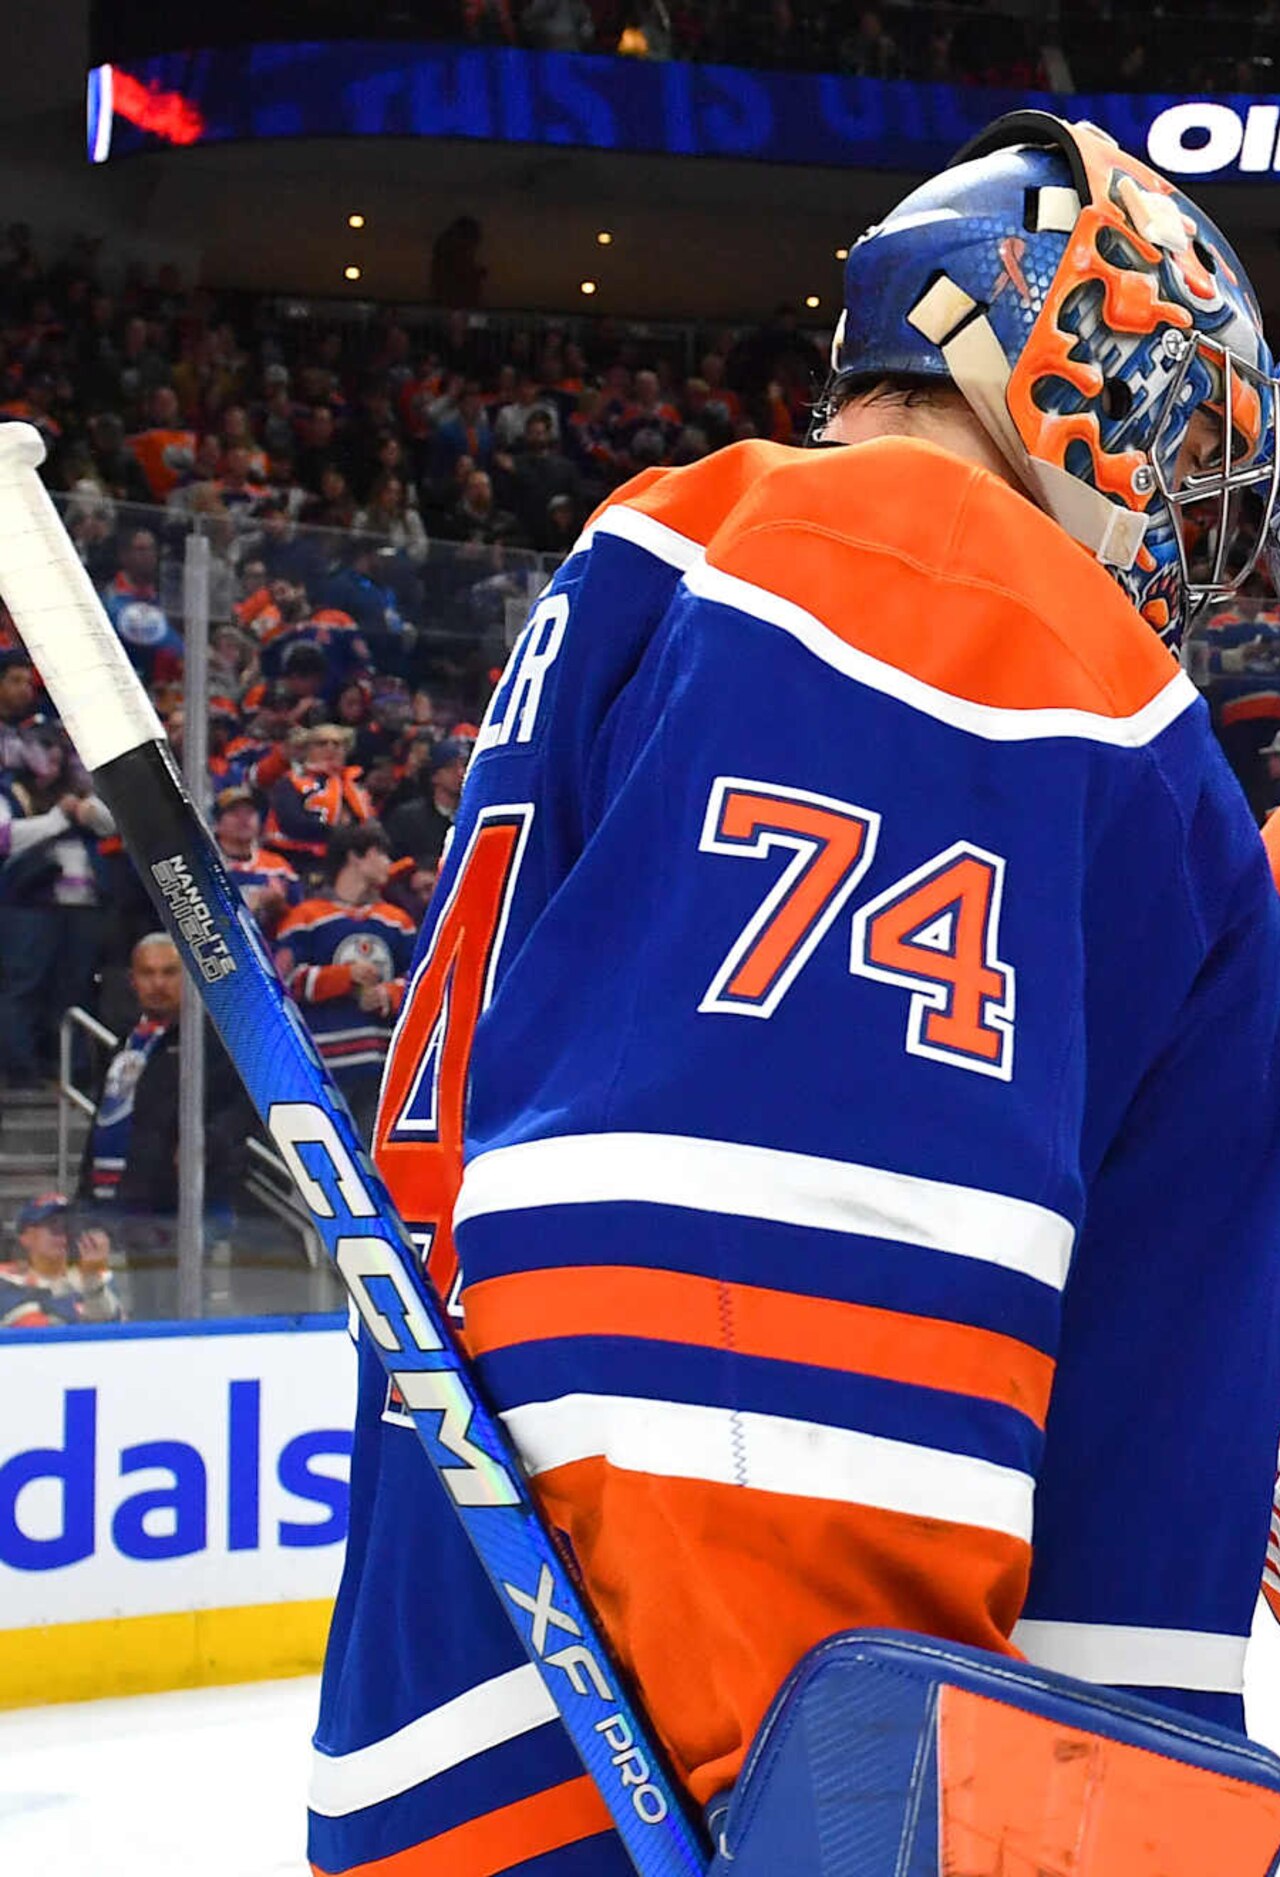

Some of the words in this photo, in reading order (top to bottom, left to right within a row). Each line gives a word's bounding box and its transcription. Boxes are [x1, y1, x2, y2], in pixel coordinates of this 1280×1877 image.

[151, 858, 224, 984] SHIELD
[169, 854, 237, 976] NANOLITE
[696, 775, 1016, 1083] 74
[267, 1101, 523, 1507] CCM
[0, 1377, 355, 1573] dals
[503, 1562, 616, 1704] XF
[594, 1711, 669, 1825] PRO
